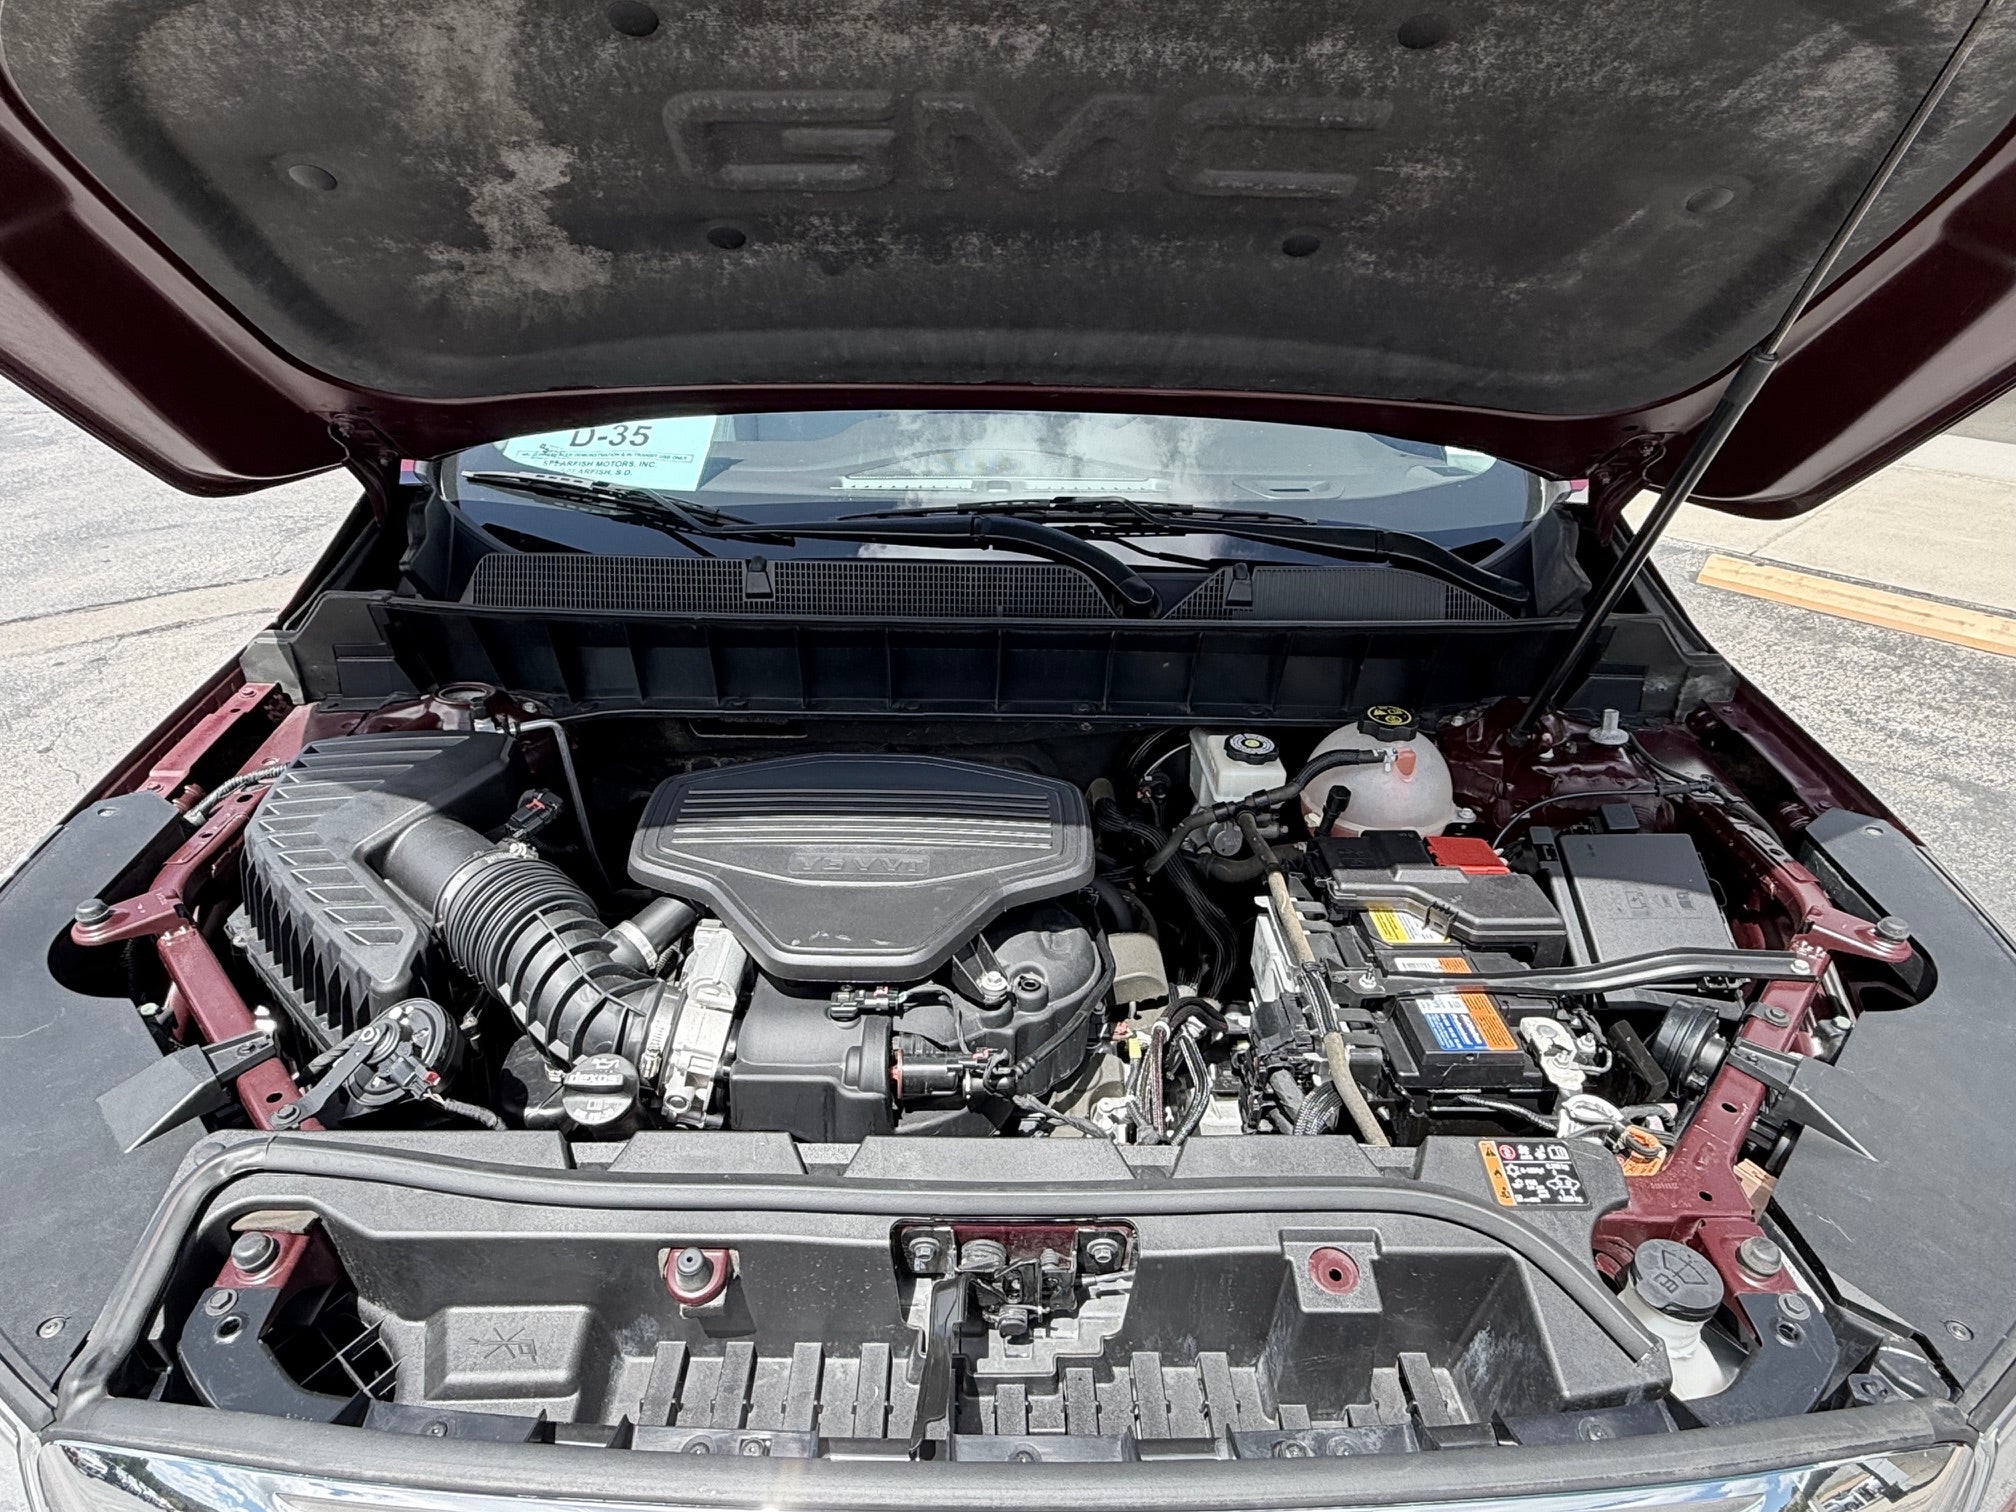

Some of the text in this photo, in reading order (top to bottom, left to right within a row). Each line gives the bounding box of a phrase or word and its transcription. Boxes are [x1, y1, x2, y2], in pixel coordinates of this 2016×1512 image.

[663, 90, 1392, 197] GMC
[569, 424, 652, 447] D-35
[639, 461, 657, 469] INC.
